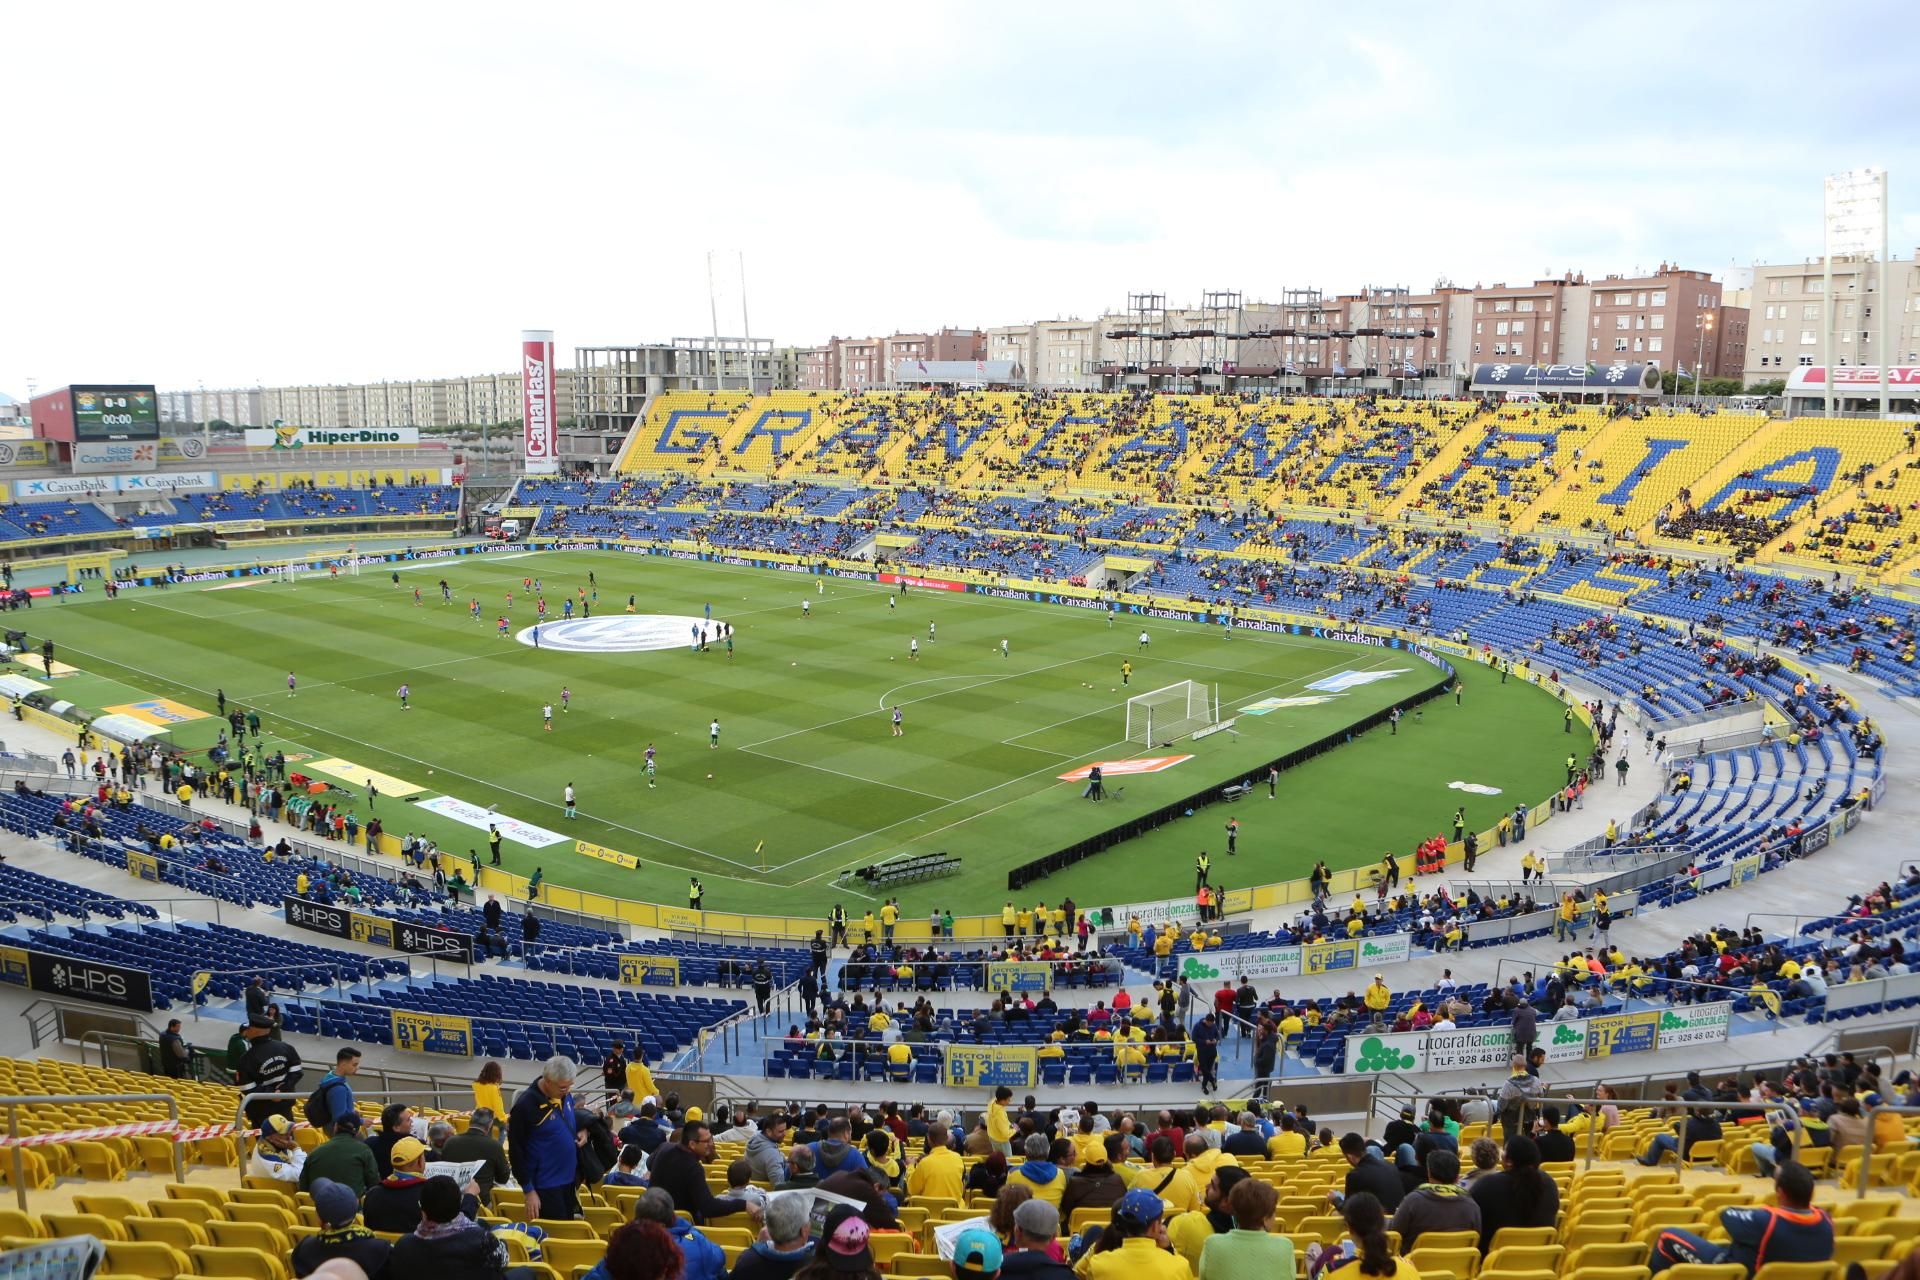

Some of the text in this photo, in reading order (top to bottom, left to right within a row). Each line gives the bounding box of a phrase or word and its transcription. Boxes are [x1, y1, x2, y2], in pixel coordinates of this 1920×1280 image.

[526, 354, 546, 456] Canarias7
[102, 414, 132, 424] 00:00
[308, 431, 400, 444] HiperDino
[106, 446, 132, 454] Islas
[81, 454, 132, 464] Canarias
[145, 472, 204, 487] CaixaBank
[48, 480, 108, 494] CaixaBank
[481, 544, 526, 554] CaixaBank
[553, 542, 599, 551] CaixaBank
[413, 549, 456, 560] CaixaBank
[668, 550, 700, 560] CaixaBank
[718, 556, 752, 567] CaixaBank
[773, 562, 810, 574] CaixaBank
[174, 571, 229, 584] CaixaBank
[833, 568, 872, 581] CaixaBank
[984, 586, 1030, 600] CaixaBank
[1059, 596, 1109, 611] CaixaBank
[1140, 606, 1193, 622] CaixaBank
[1229, 616, 1286, 634] CaixaBank
[1323, 630, 1385, 647] CaixaBank
[1434, 640, 1468, 656] Canarias7
[1414, 645, 1441, 666] CaixaBank
[512, 828, 550, 842] LaLiga
[302, 907, 342, 929] HPS
[415, 931, 461, 954] HPS
[1310, 953, 1333, 965] C14
[622, 964, 650, 977] C12
[68, 966, 127, 995] HPS
[992, 973, 1020, 985] C13
[397, 1016, 432, 1026] SECTOR
[1589, 1020, 1623, 1029] SECTOR
[397, 1023, 434, 1041] B12
[1589, 1028, 1624, 1047] B14
[1659, 1036, 1676, 1045] TLF.
[1678, 1034, 1691, 1043] 928
[1705, 1032, 1714, 1040] 02
[1716, 1030, 1727, 1038] 04
[1434, 1057, 1455, 1066] TLF.
[1459, 1055, 1477, 1064] 928
[1480, 1054, 1492, 1063] 48
[1495, 1053, 1507, 1062] 02
[952, 1060, 992, 1076] B13
